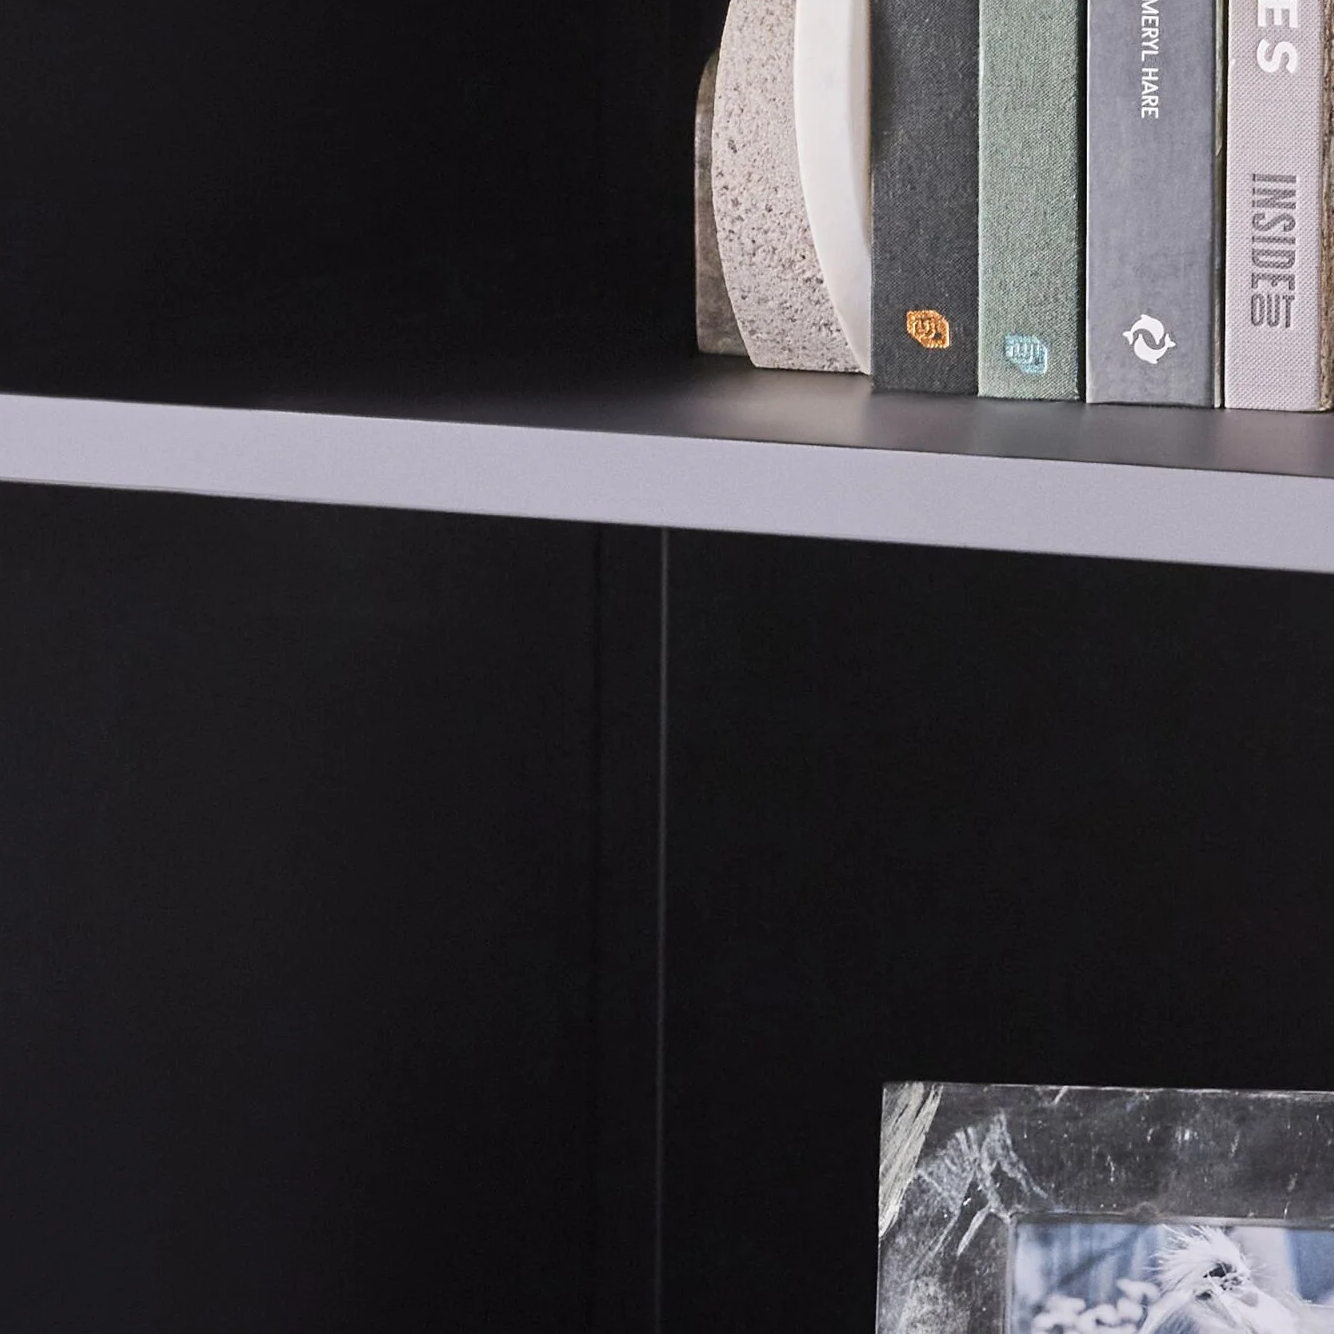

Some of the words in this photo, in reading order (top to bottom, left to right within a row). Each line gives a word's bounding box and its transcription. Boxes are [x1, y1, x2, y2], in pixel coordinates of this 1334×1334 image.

[1140, 67, 1159, 120] HARE
[1250, 173, 1297, 291] INSIDE
[1250, 293, 1295, 329] OUT
